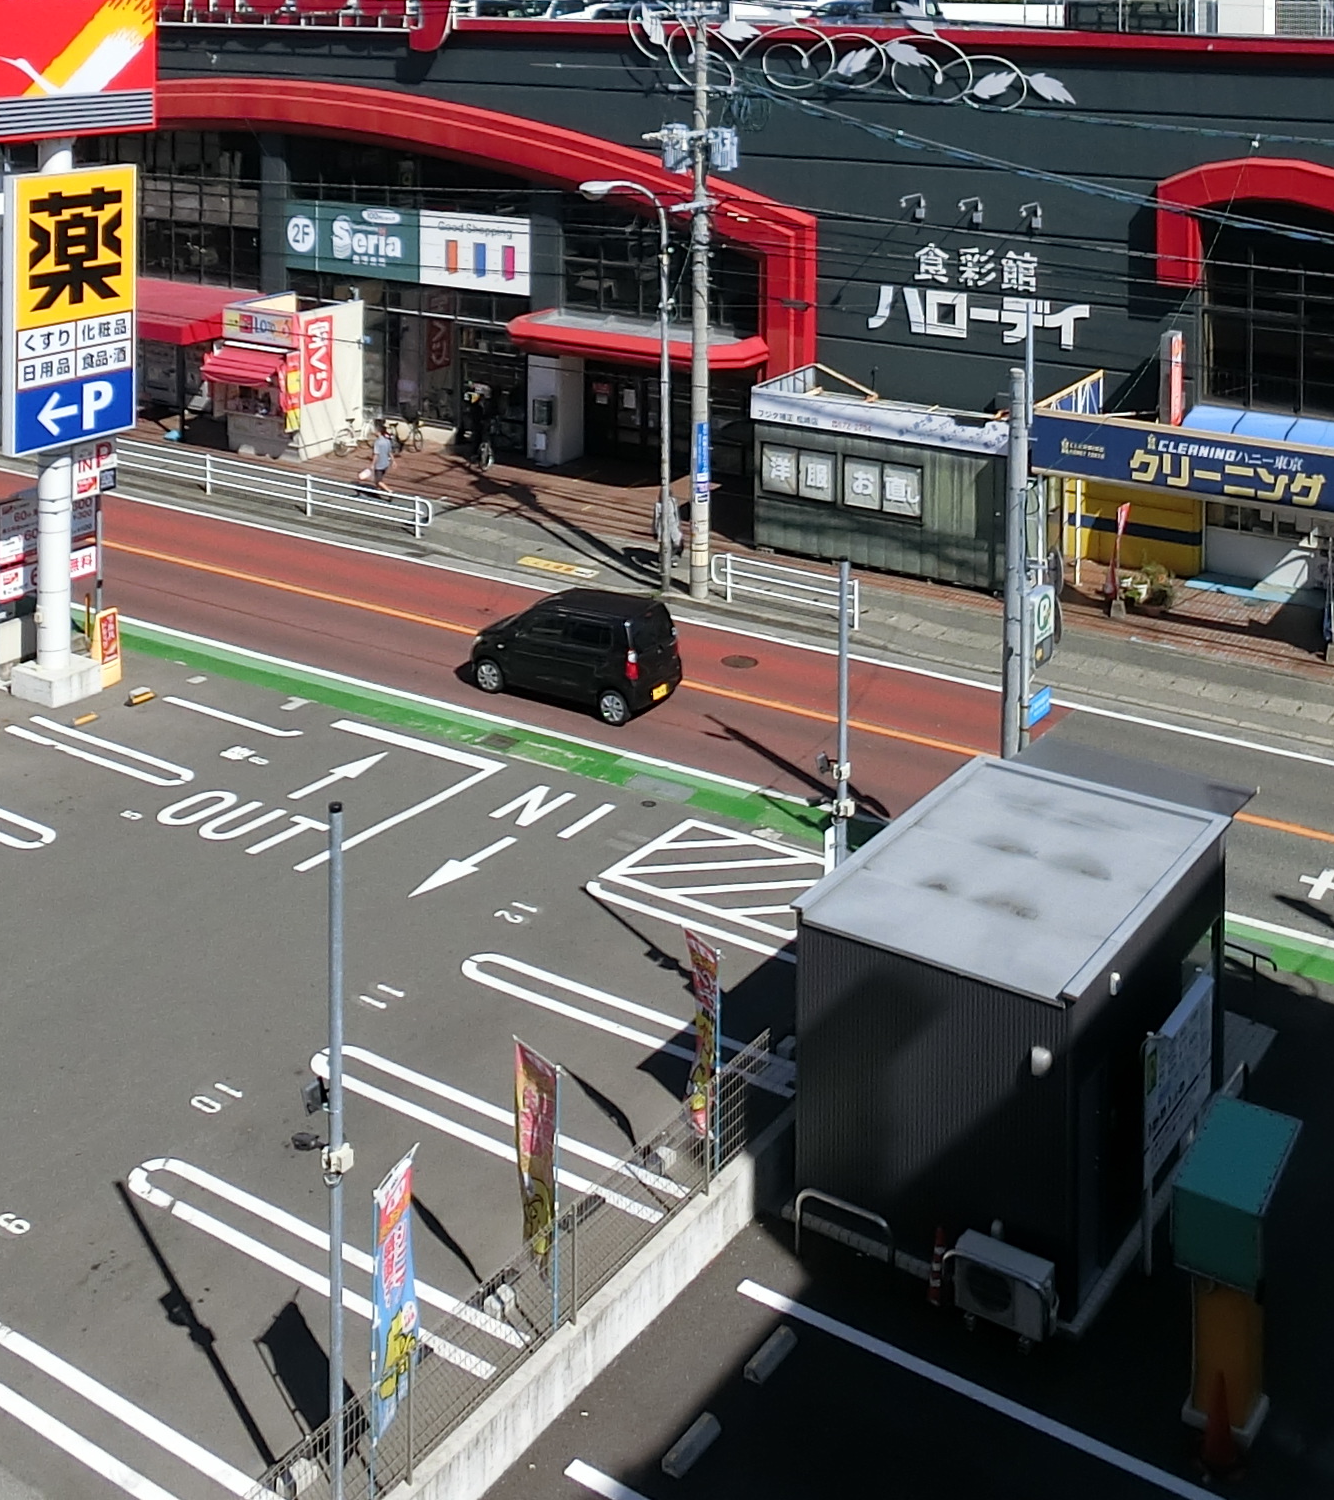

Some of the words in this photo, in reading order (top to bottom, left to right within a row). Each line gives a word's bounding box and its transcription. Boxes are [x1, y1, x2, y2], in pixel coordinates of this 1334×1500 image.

[292, 223, 310, 244] 2F
[332, 216, 402, 259] Seria
[438, 221, 464, 233] Good
[466, 224, 513, 239] Shopping
[29, 186, 122, 312] 薬
[914, 243, 1038, 292] 食彩館
[81, 318, 127, 342] 化粧品
[868, 285, 1090, 350] ハローディ
[24, 329, 71, 351] くすり
[23, 361, 71, 383] 日用品
[82, 380, 113, 430] P
[78, 457, 93, 474] IN
[96, 442, 112, 468] P
[1158, 439, 1236, 462] CLEANING
[1236, 450, 1304, 472] ハニー東京
[1130, 449, 1326, 507] クリーニング
[157, 790, 331, 855] OUT
[488, 784, 617, 839] IN
[494, 901, 538, 924] 12
[359, 984, 405, 1009] 11
[191, 1082, 243, 1114] 10
